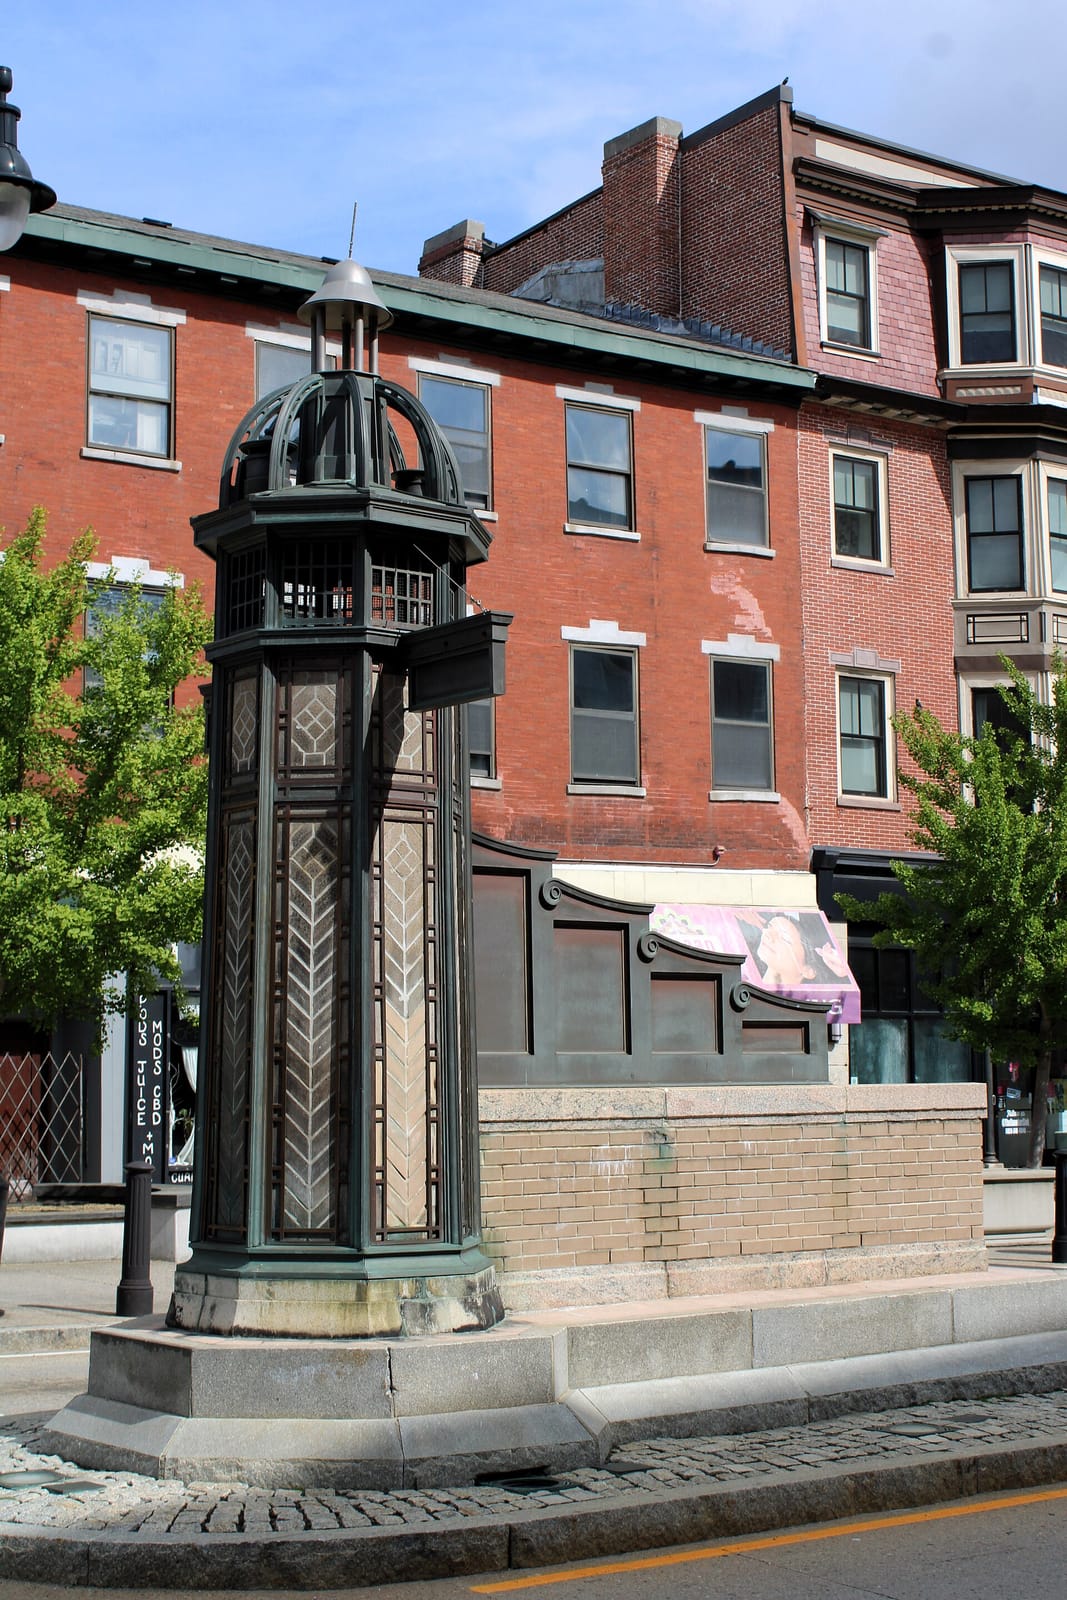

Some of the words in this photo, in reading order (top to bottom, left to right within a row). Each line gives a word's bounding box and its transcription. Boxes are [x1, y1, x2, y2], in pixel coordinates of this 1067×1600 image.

[152, 1020, 163, 1075] MODS
[137, 1061, 147, 1126] JUICE
[152, 1085, 162, 1126] CBD
